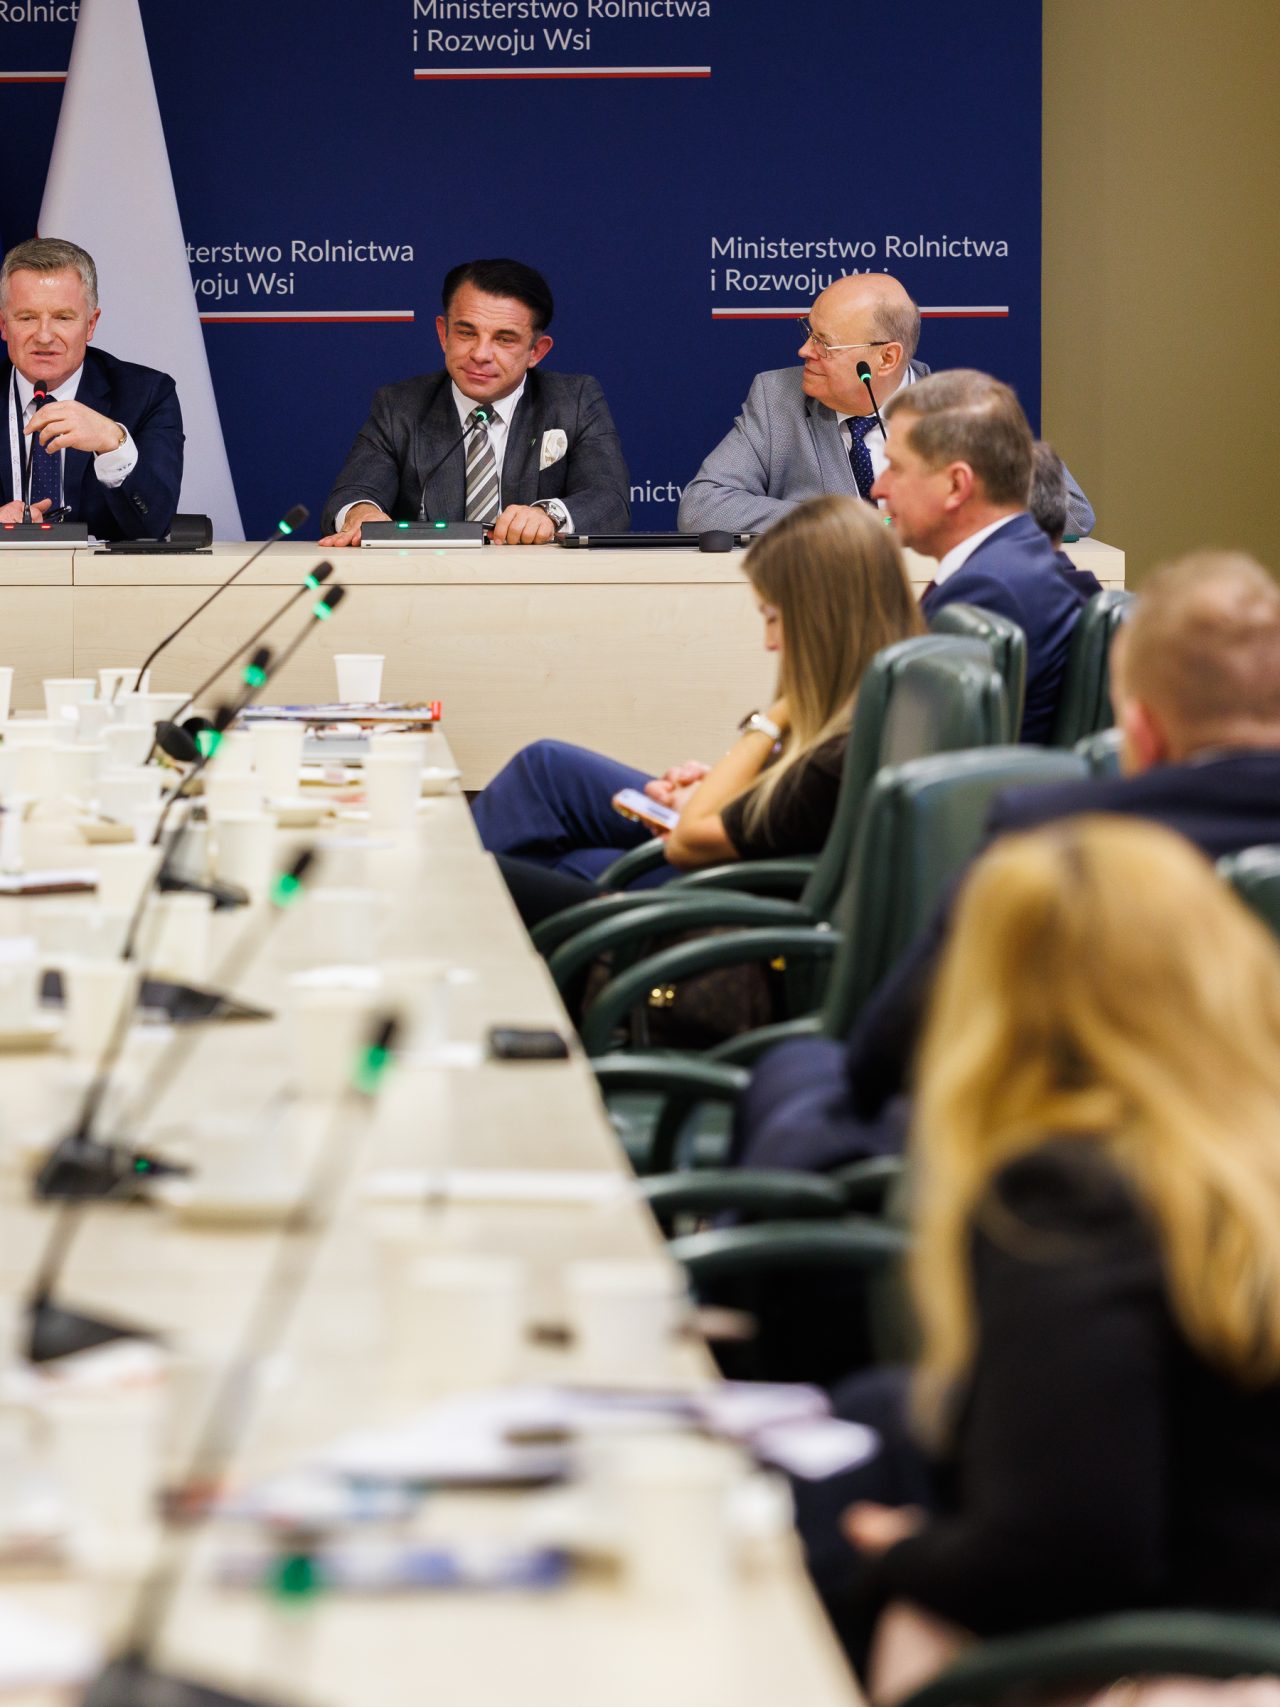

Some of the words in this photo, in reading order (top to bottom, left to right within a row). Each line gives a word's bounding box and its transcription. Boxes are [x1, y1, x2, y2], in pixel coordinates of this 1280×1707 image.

[413, 0, 579, 19] Ministerstwo
[587, 0, 711, 18] Rolnictwa
[412, 29, 418, 52] i
[427, 28, 535, 56] Rozwoju
[543, 28, 591, 51] Wsi
[185, 241, 282, 263] terstwo
[291, 239, 415, 263] Rolnictwa
[711, 236, 877, 259] Ministerstwo
[885, 235, 1009, 258] Rolnictwa
[247, 272, 295, 295] Wsi
[710, 268, 716, 292] i
[725, 268, 832, 296] Rozwoju
